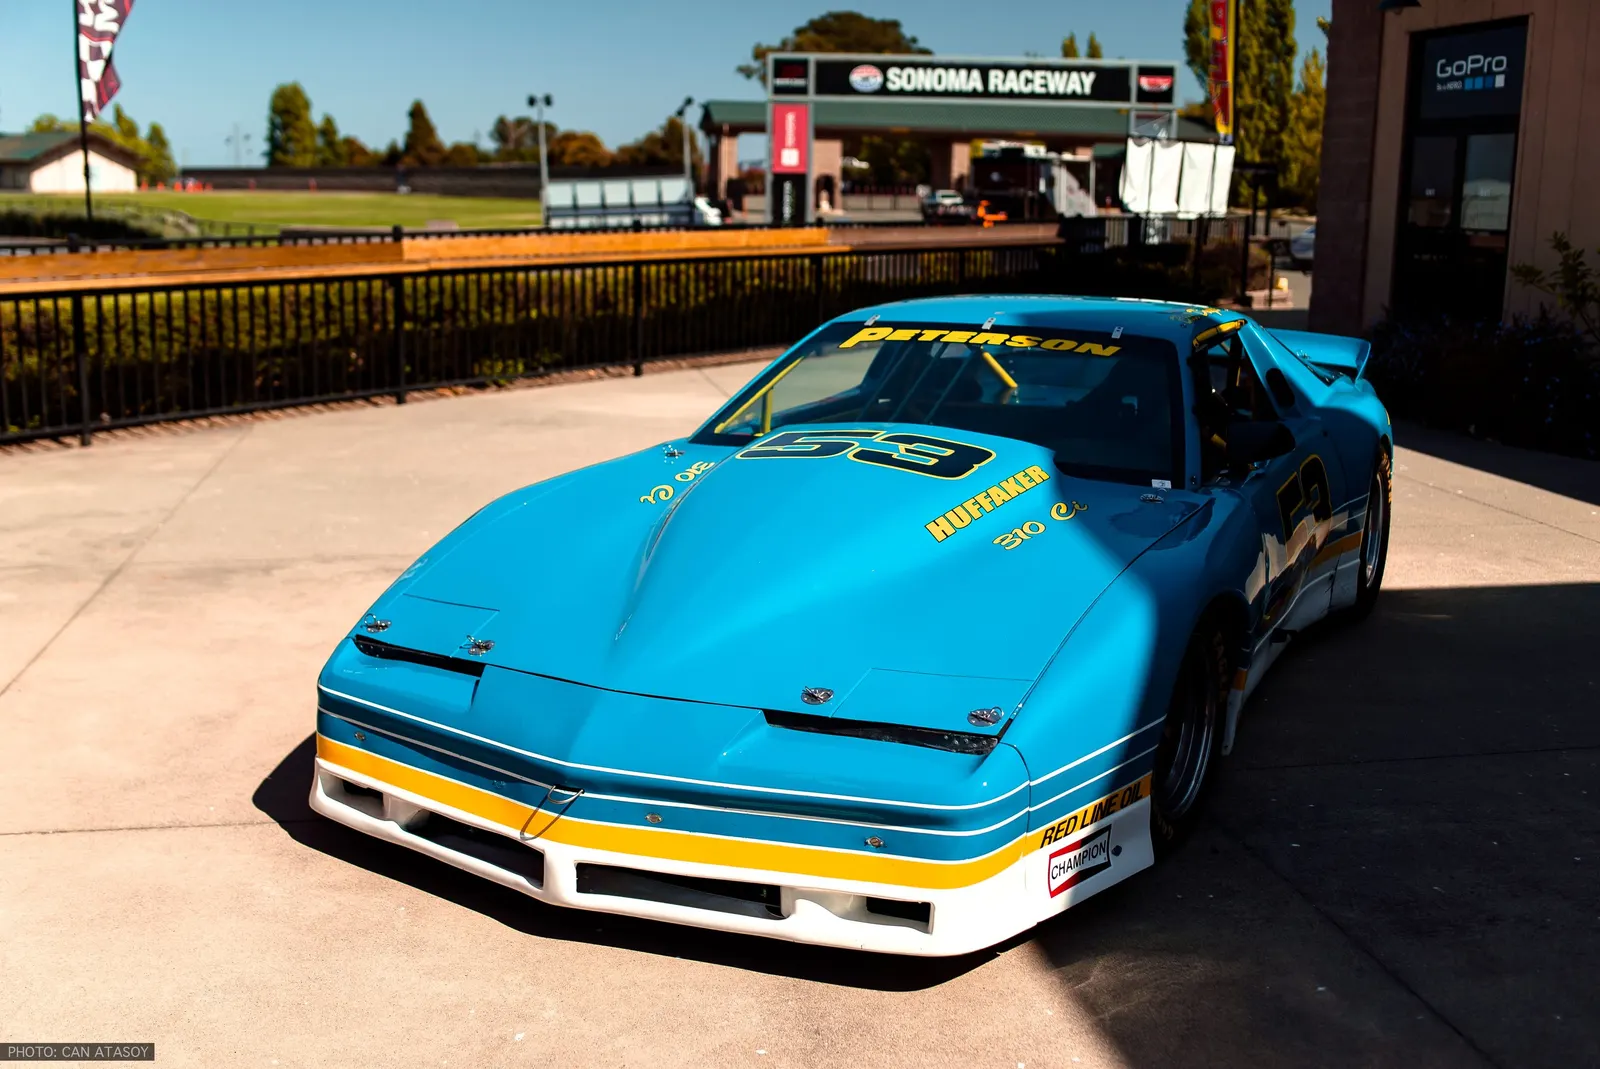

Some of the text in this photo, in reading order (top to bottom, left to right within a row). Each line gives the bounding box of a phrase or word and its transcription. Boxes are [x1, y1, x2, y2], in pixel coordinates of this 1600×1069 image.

[886, 66, 1096, 95] SONOMA RACEWAY
[1436, 55, 1507, 78] GoPro
[838, 326, 1123, 357] PETERSON
[736, 429, 996, 480] 53
[925, 465, 1050, 543] HUFFAKER
[992, 499, 1089, 551] 310 Ci
[1040, 815, 1078, 849] RED
[1080, 794, 1119, 830] LINE
[1119, 781, 1143, 807] OIL
[1051, 839, 1106, 880] CHAMPION
